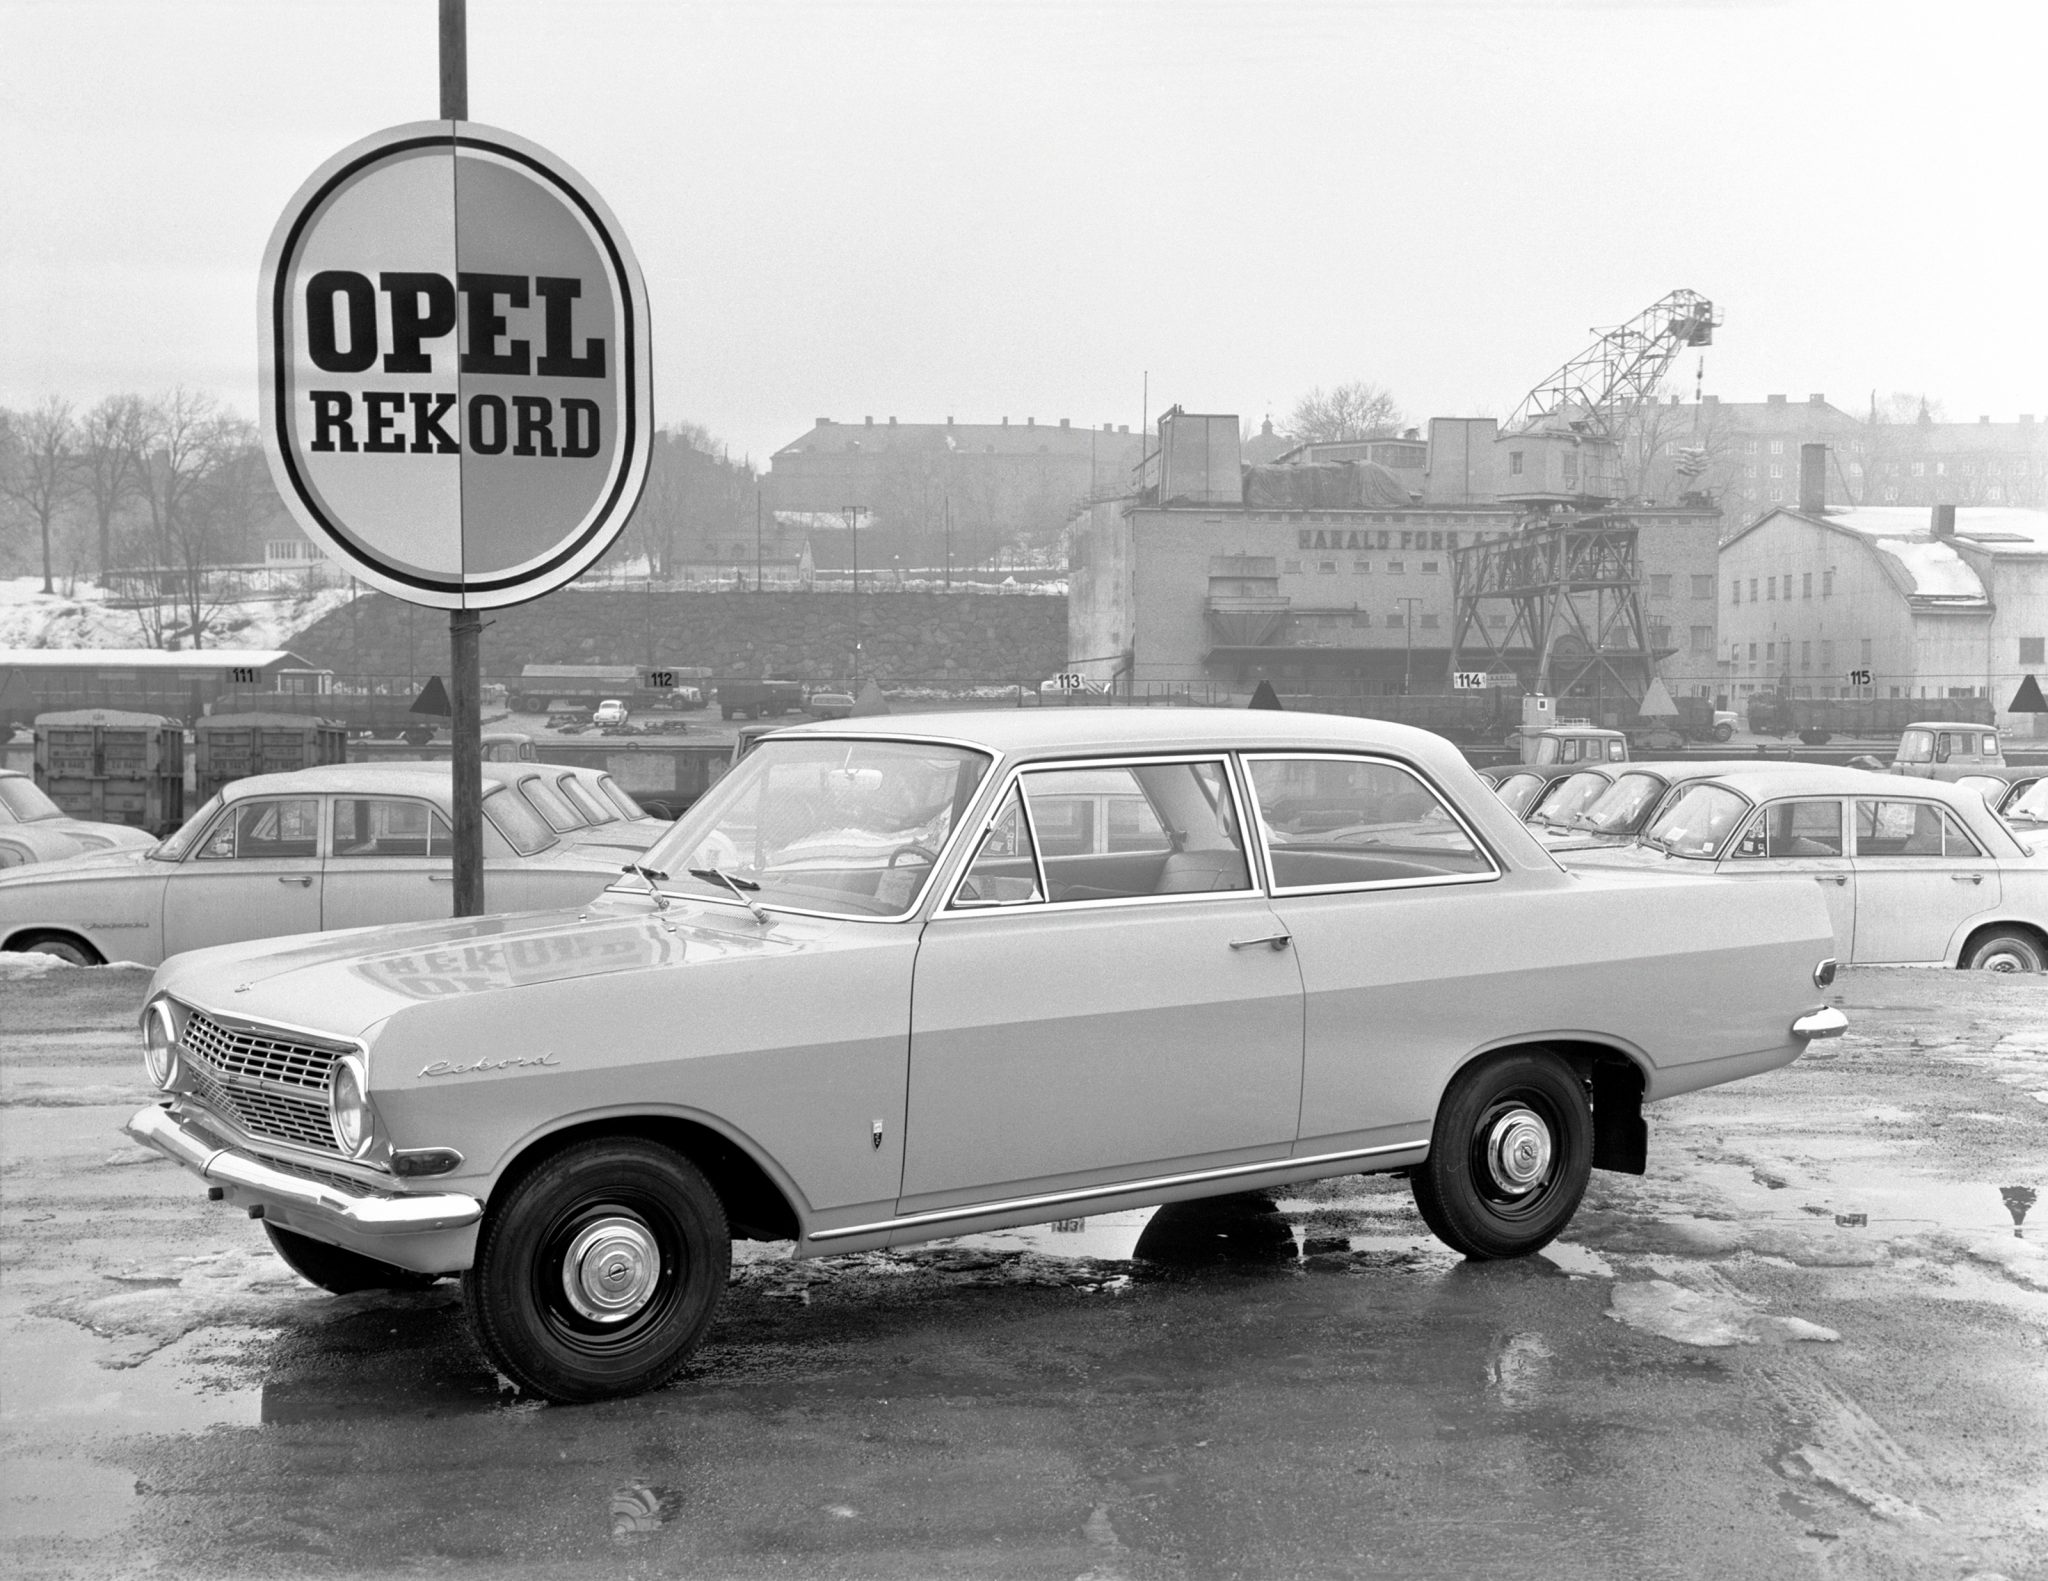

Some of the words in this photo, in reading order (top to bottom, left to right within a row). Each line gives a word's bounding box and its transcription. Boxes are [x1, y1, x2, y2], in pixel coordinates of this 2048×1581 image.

[306, 270, 606, 378] OPEL
[309, 391, 600, 458] REKORD
[1299, 530, 1389, 549] HARALD
[233, 668, 253, 682] 111
[651, 672, 672, 687] 112
[1058, 674, 1080, 688] 113
[1458, 673, 1481, 688] 114
[1850, 670, 1871, 685] 115
[416, 1051, 561, 1079] Rekord
